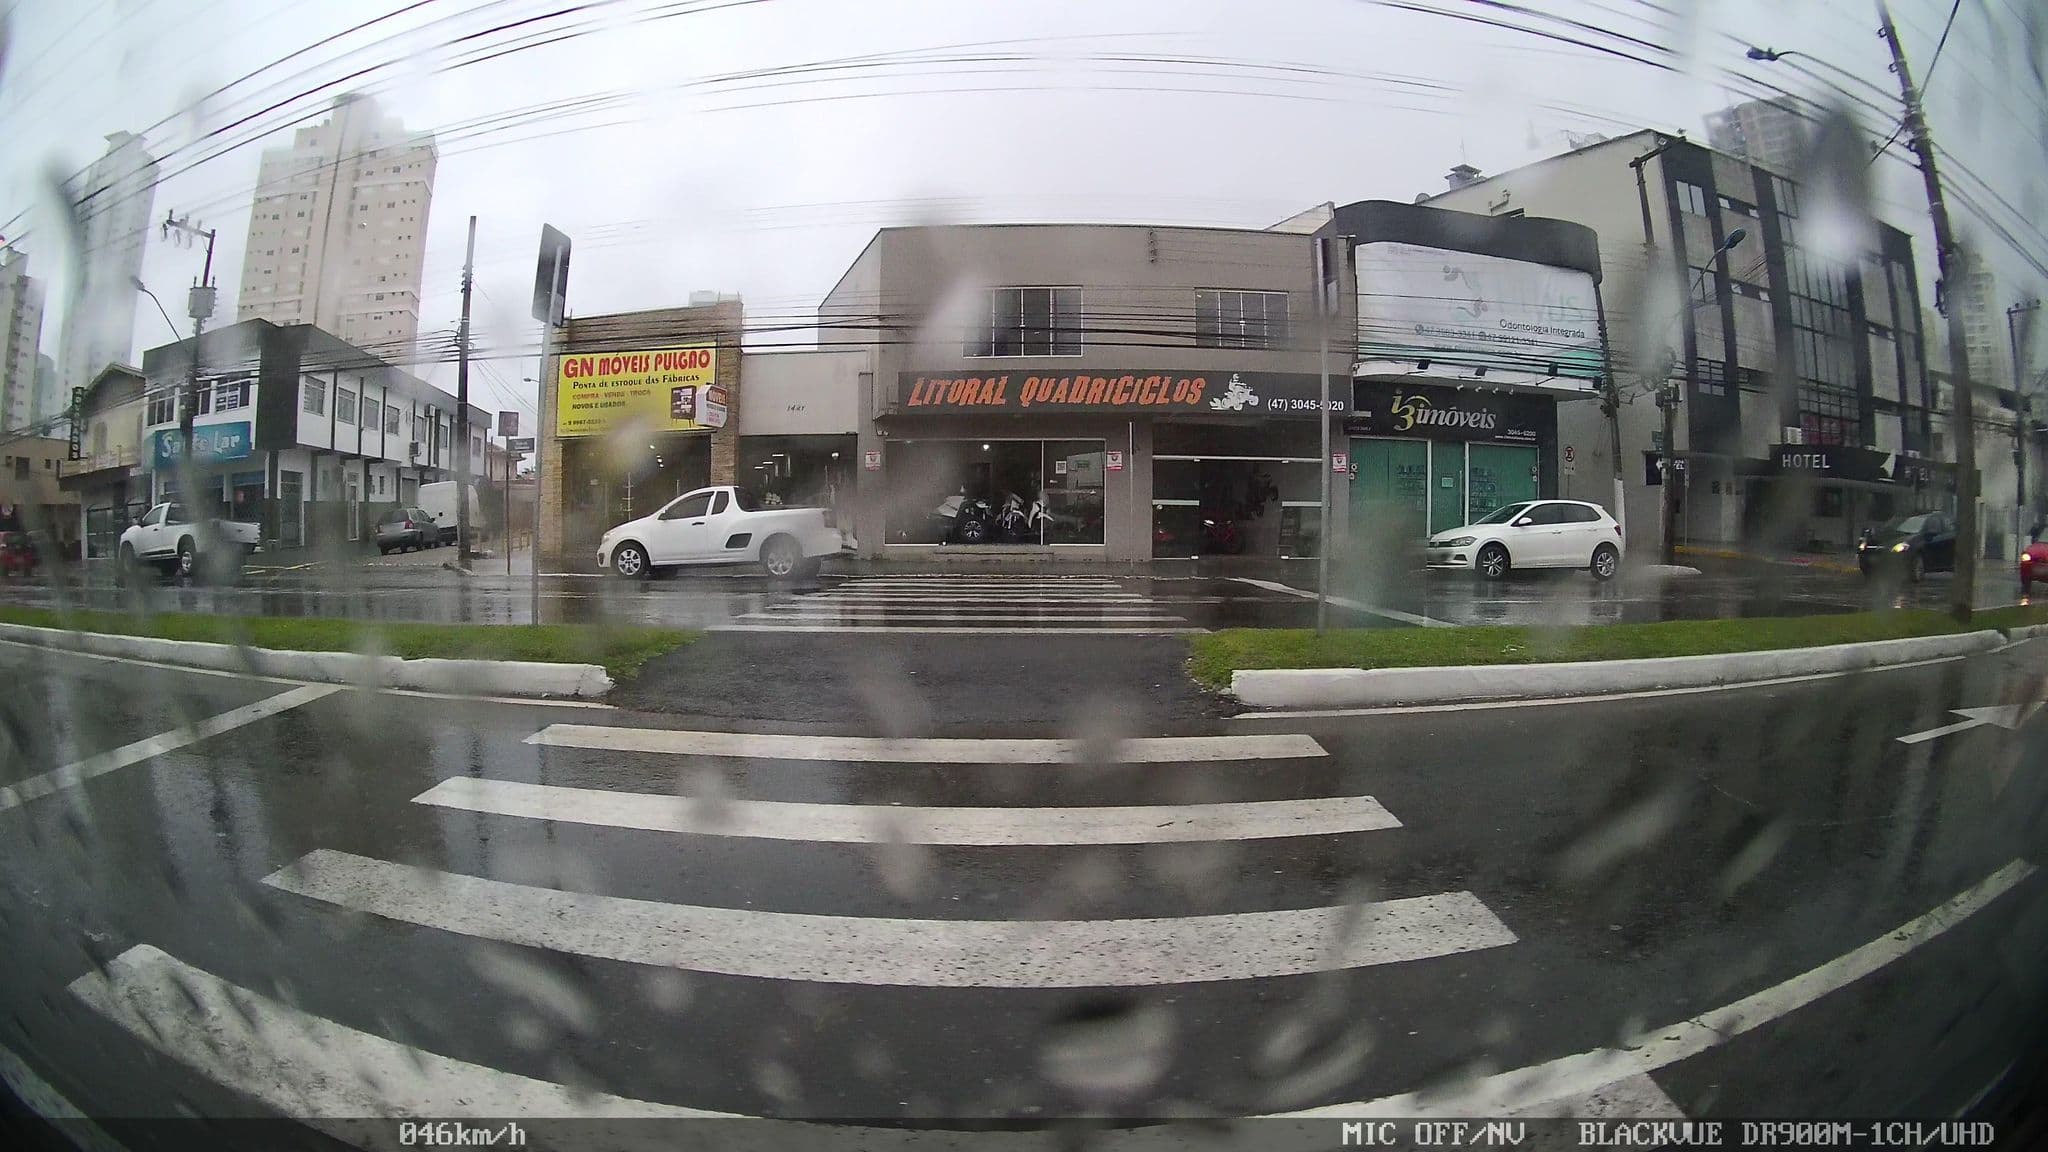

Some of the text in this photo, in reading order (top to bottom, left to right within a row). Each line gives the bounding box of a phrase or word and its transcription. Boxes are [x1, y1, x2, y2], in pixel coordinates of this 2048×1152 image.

[1500, 318, 1585, 338] Odontologia Integrada
[563, 357, 593, 378] GN
[598, 353, 650, 375] MÓVEIS
[908, 374, 1207, 408] LITORAL QUADRICICLOS
[1267, 399, 1288, 411] (47)
[1416, 404, 1497, 429] imóveis
[214, 430, 241, 455] Lar
[1782, 453, 1831, 469] HOTEL
